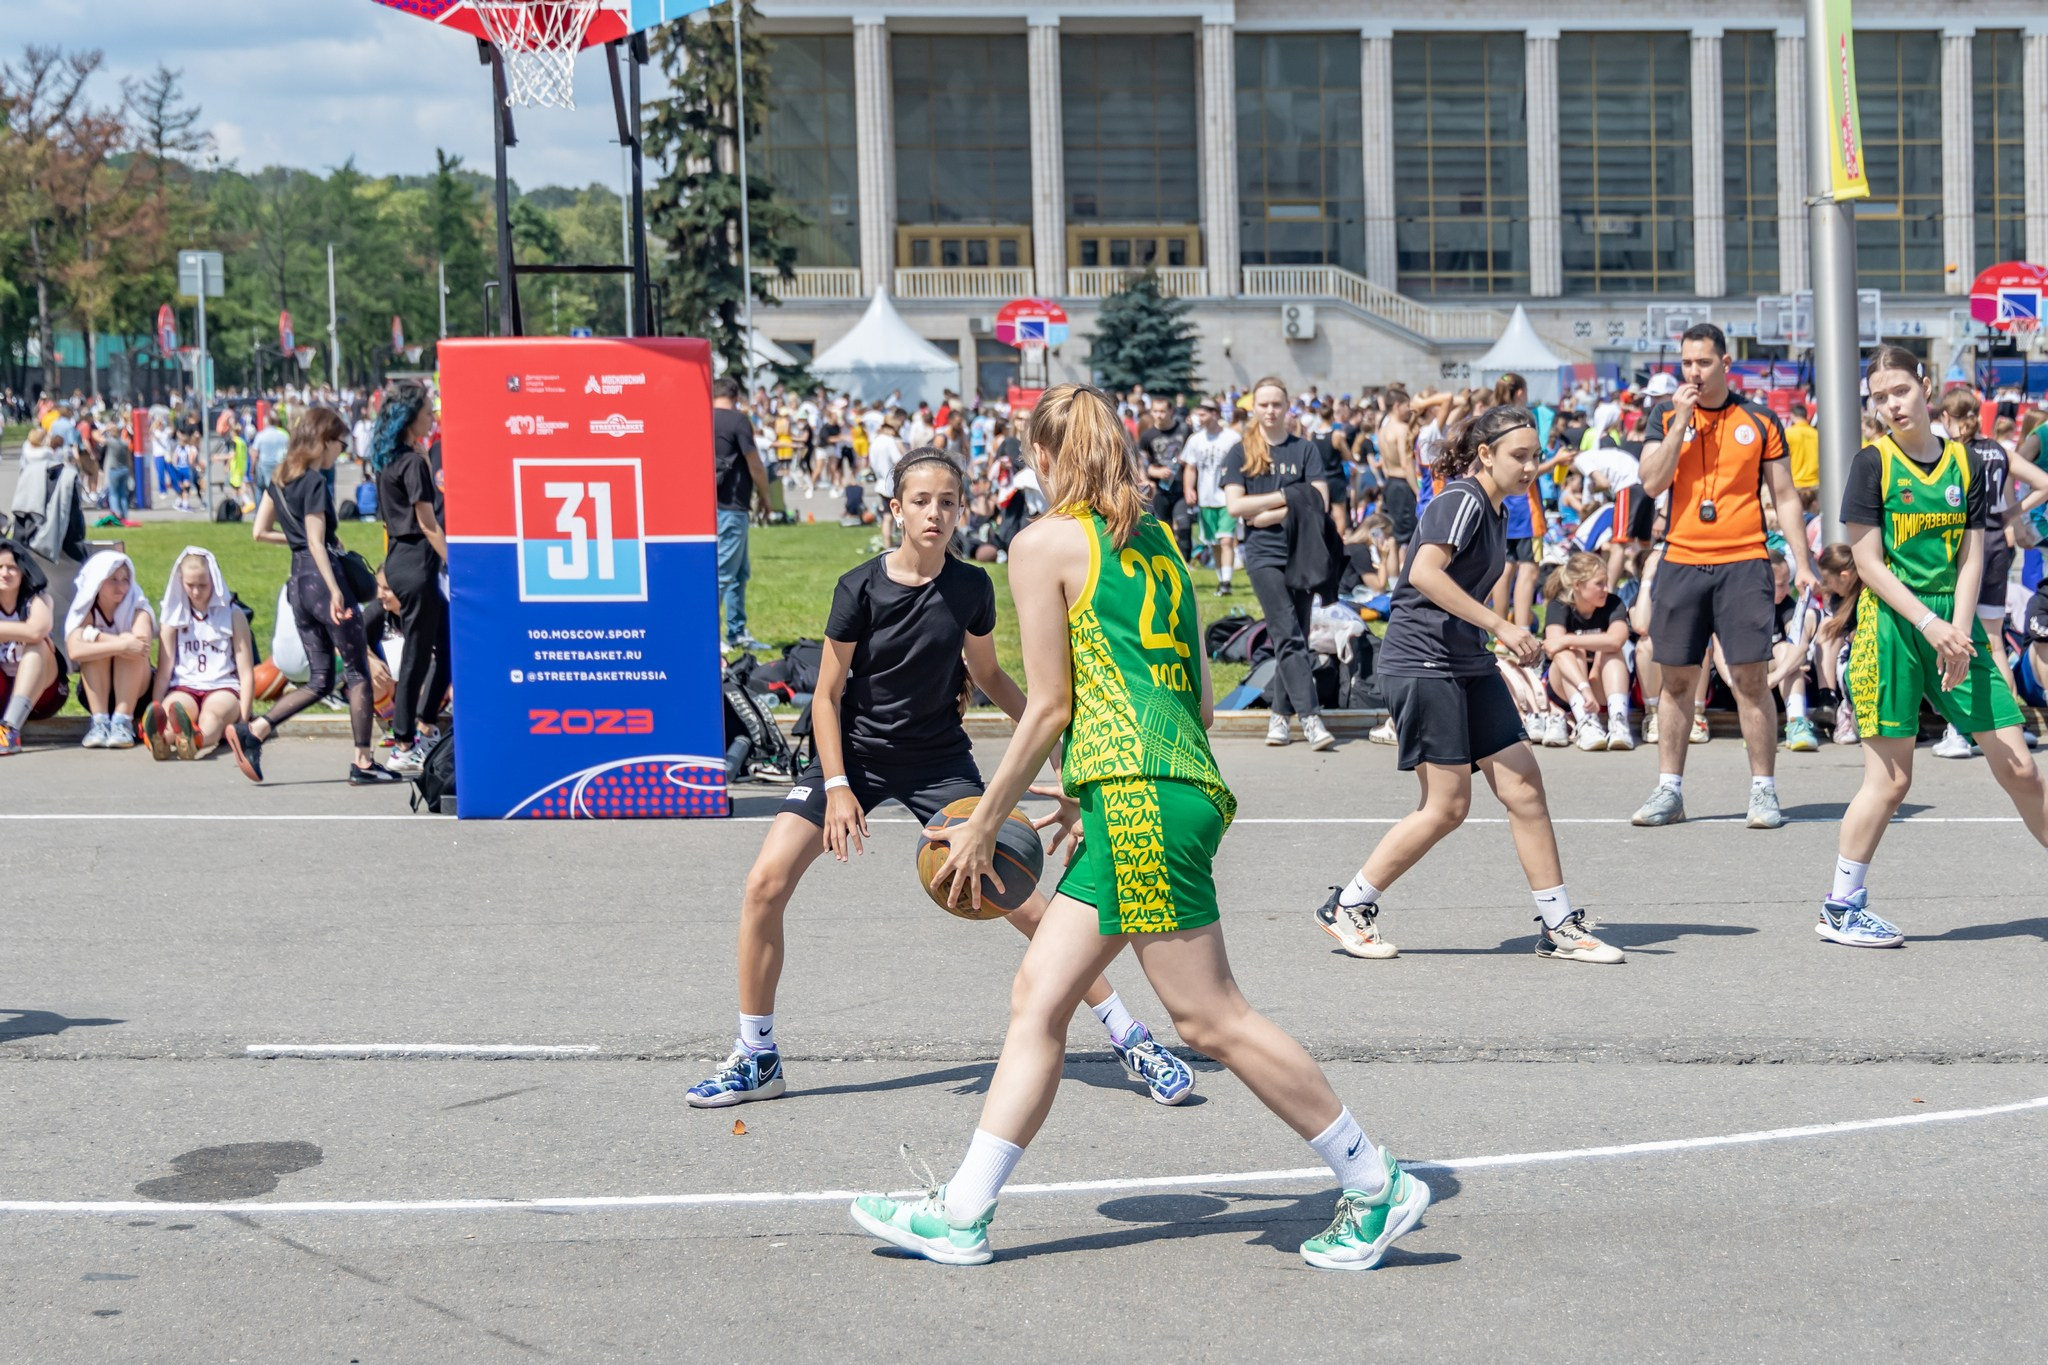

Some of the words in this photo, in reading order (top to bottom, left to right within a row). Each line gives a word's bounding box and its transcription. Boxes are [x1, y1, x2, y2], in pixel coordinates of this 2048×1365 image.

[544, 482, 615, 580] 31
[1120, 548, 1191, 658] 22
[528, 629, 646, 640] 100.MOSCOW.SPORT
[198, 654, 206, 672] 8
[534, 651, 642, 661] STREETBASKET.RU
[527, 671, 667, 682] @STREETBASKETRUSSIA
[529, 709, 654, 734] 2023
